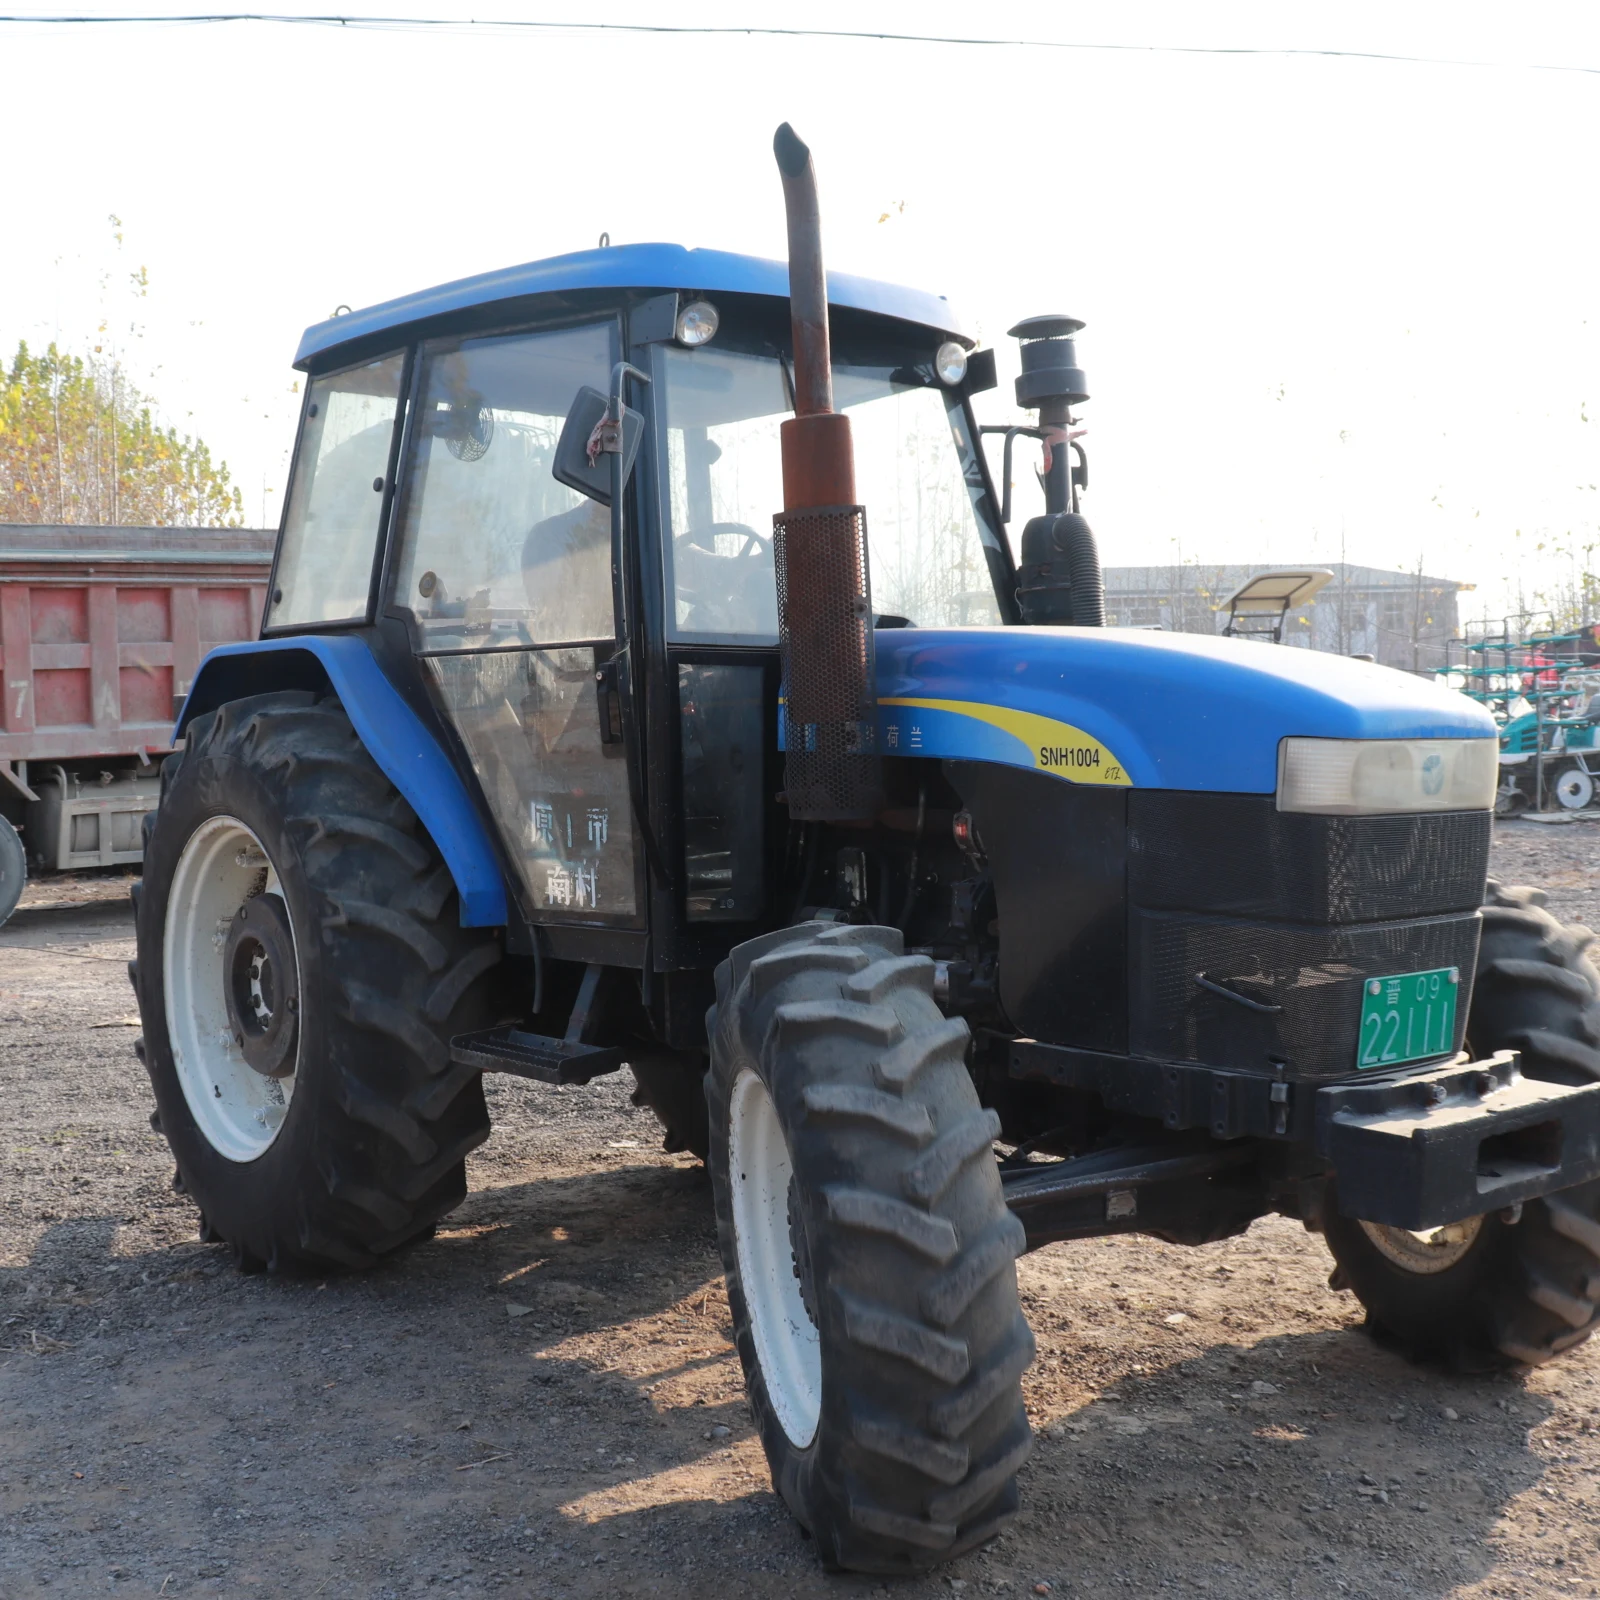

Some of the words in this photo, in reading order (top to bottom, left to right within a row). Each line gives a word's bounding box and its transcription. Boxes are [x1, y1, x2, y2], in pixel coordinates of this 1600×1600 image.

[1040, 746, 1100, 768] SNH1004
[1386, 979, 1401, 1005] 晋
[1416, 974, 1440, 1001] 09
[1361, 1001, 1448, 1065] 22111
